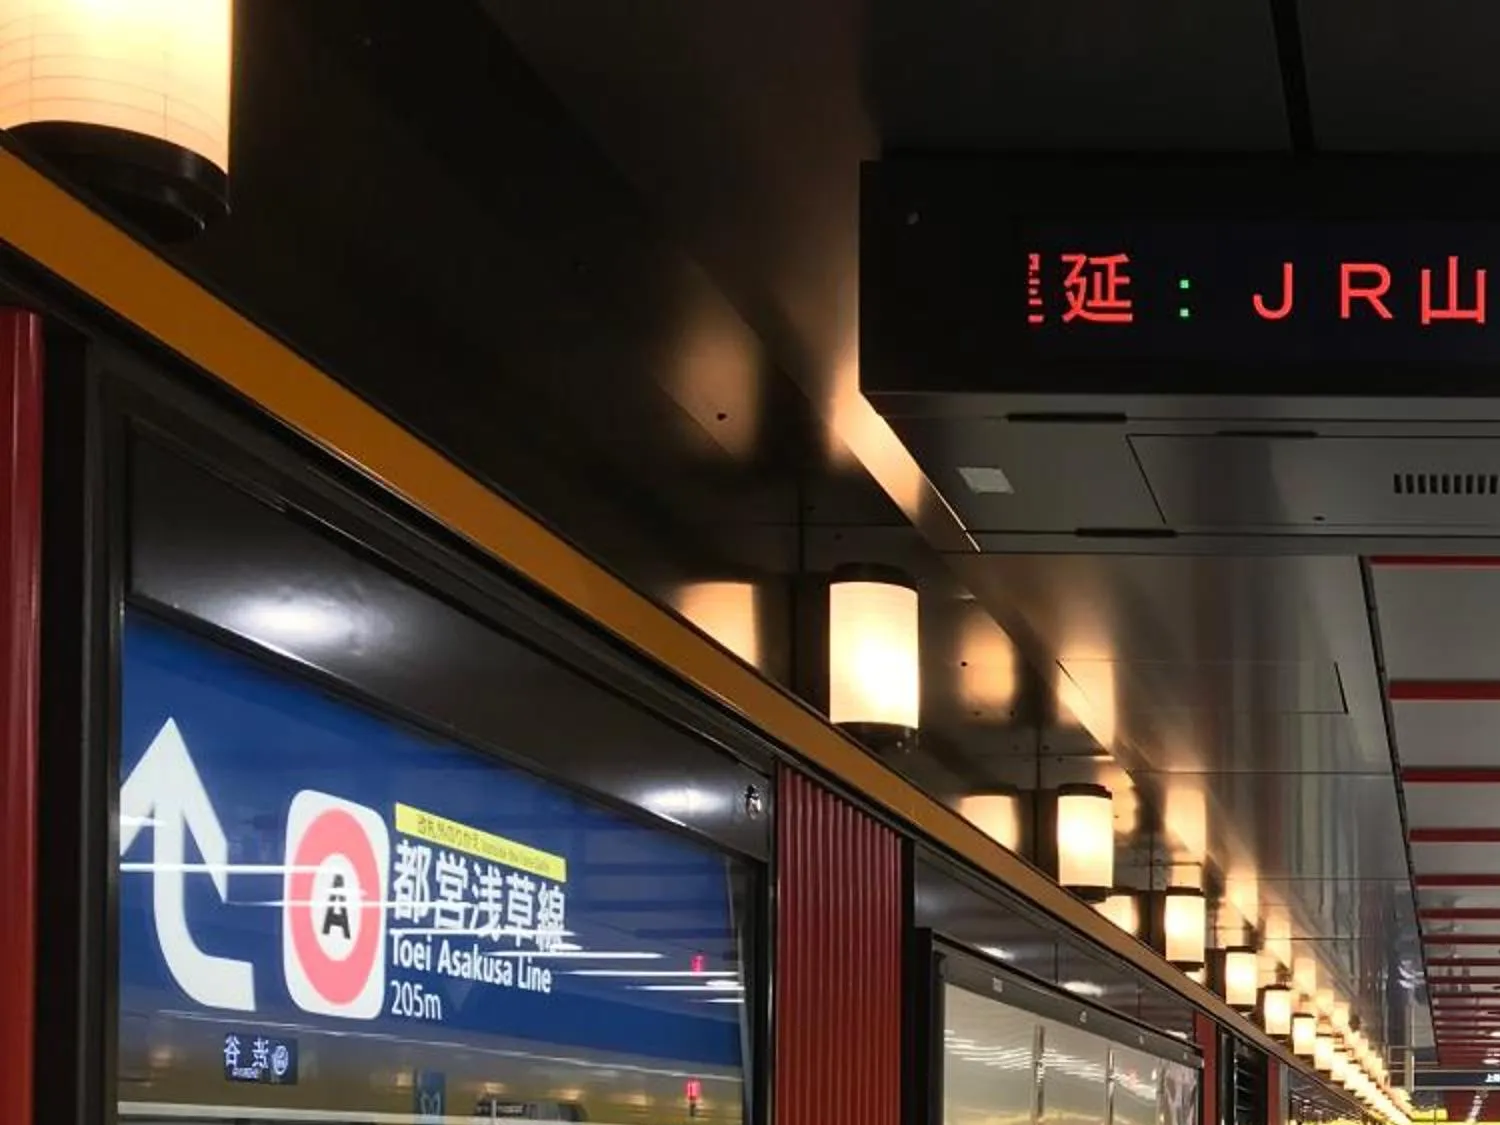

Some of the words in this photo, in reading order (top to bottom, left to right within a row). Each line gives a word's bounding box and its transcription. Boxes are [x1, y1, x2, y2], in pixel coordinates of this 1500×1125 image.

[322, 872, 351, 940] A
[393, 838, 566, 953] 都営浅草線
[393, 932, 432, 972] Toei
[437, 938, 513, 986] Asakusa
[517, 954, 552, 993] Line
[391, 980, 442, 1020] 205m
